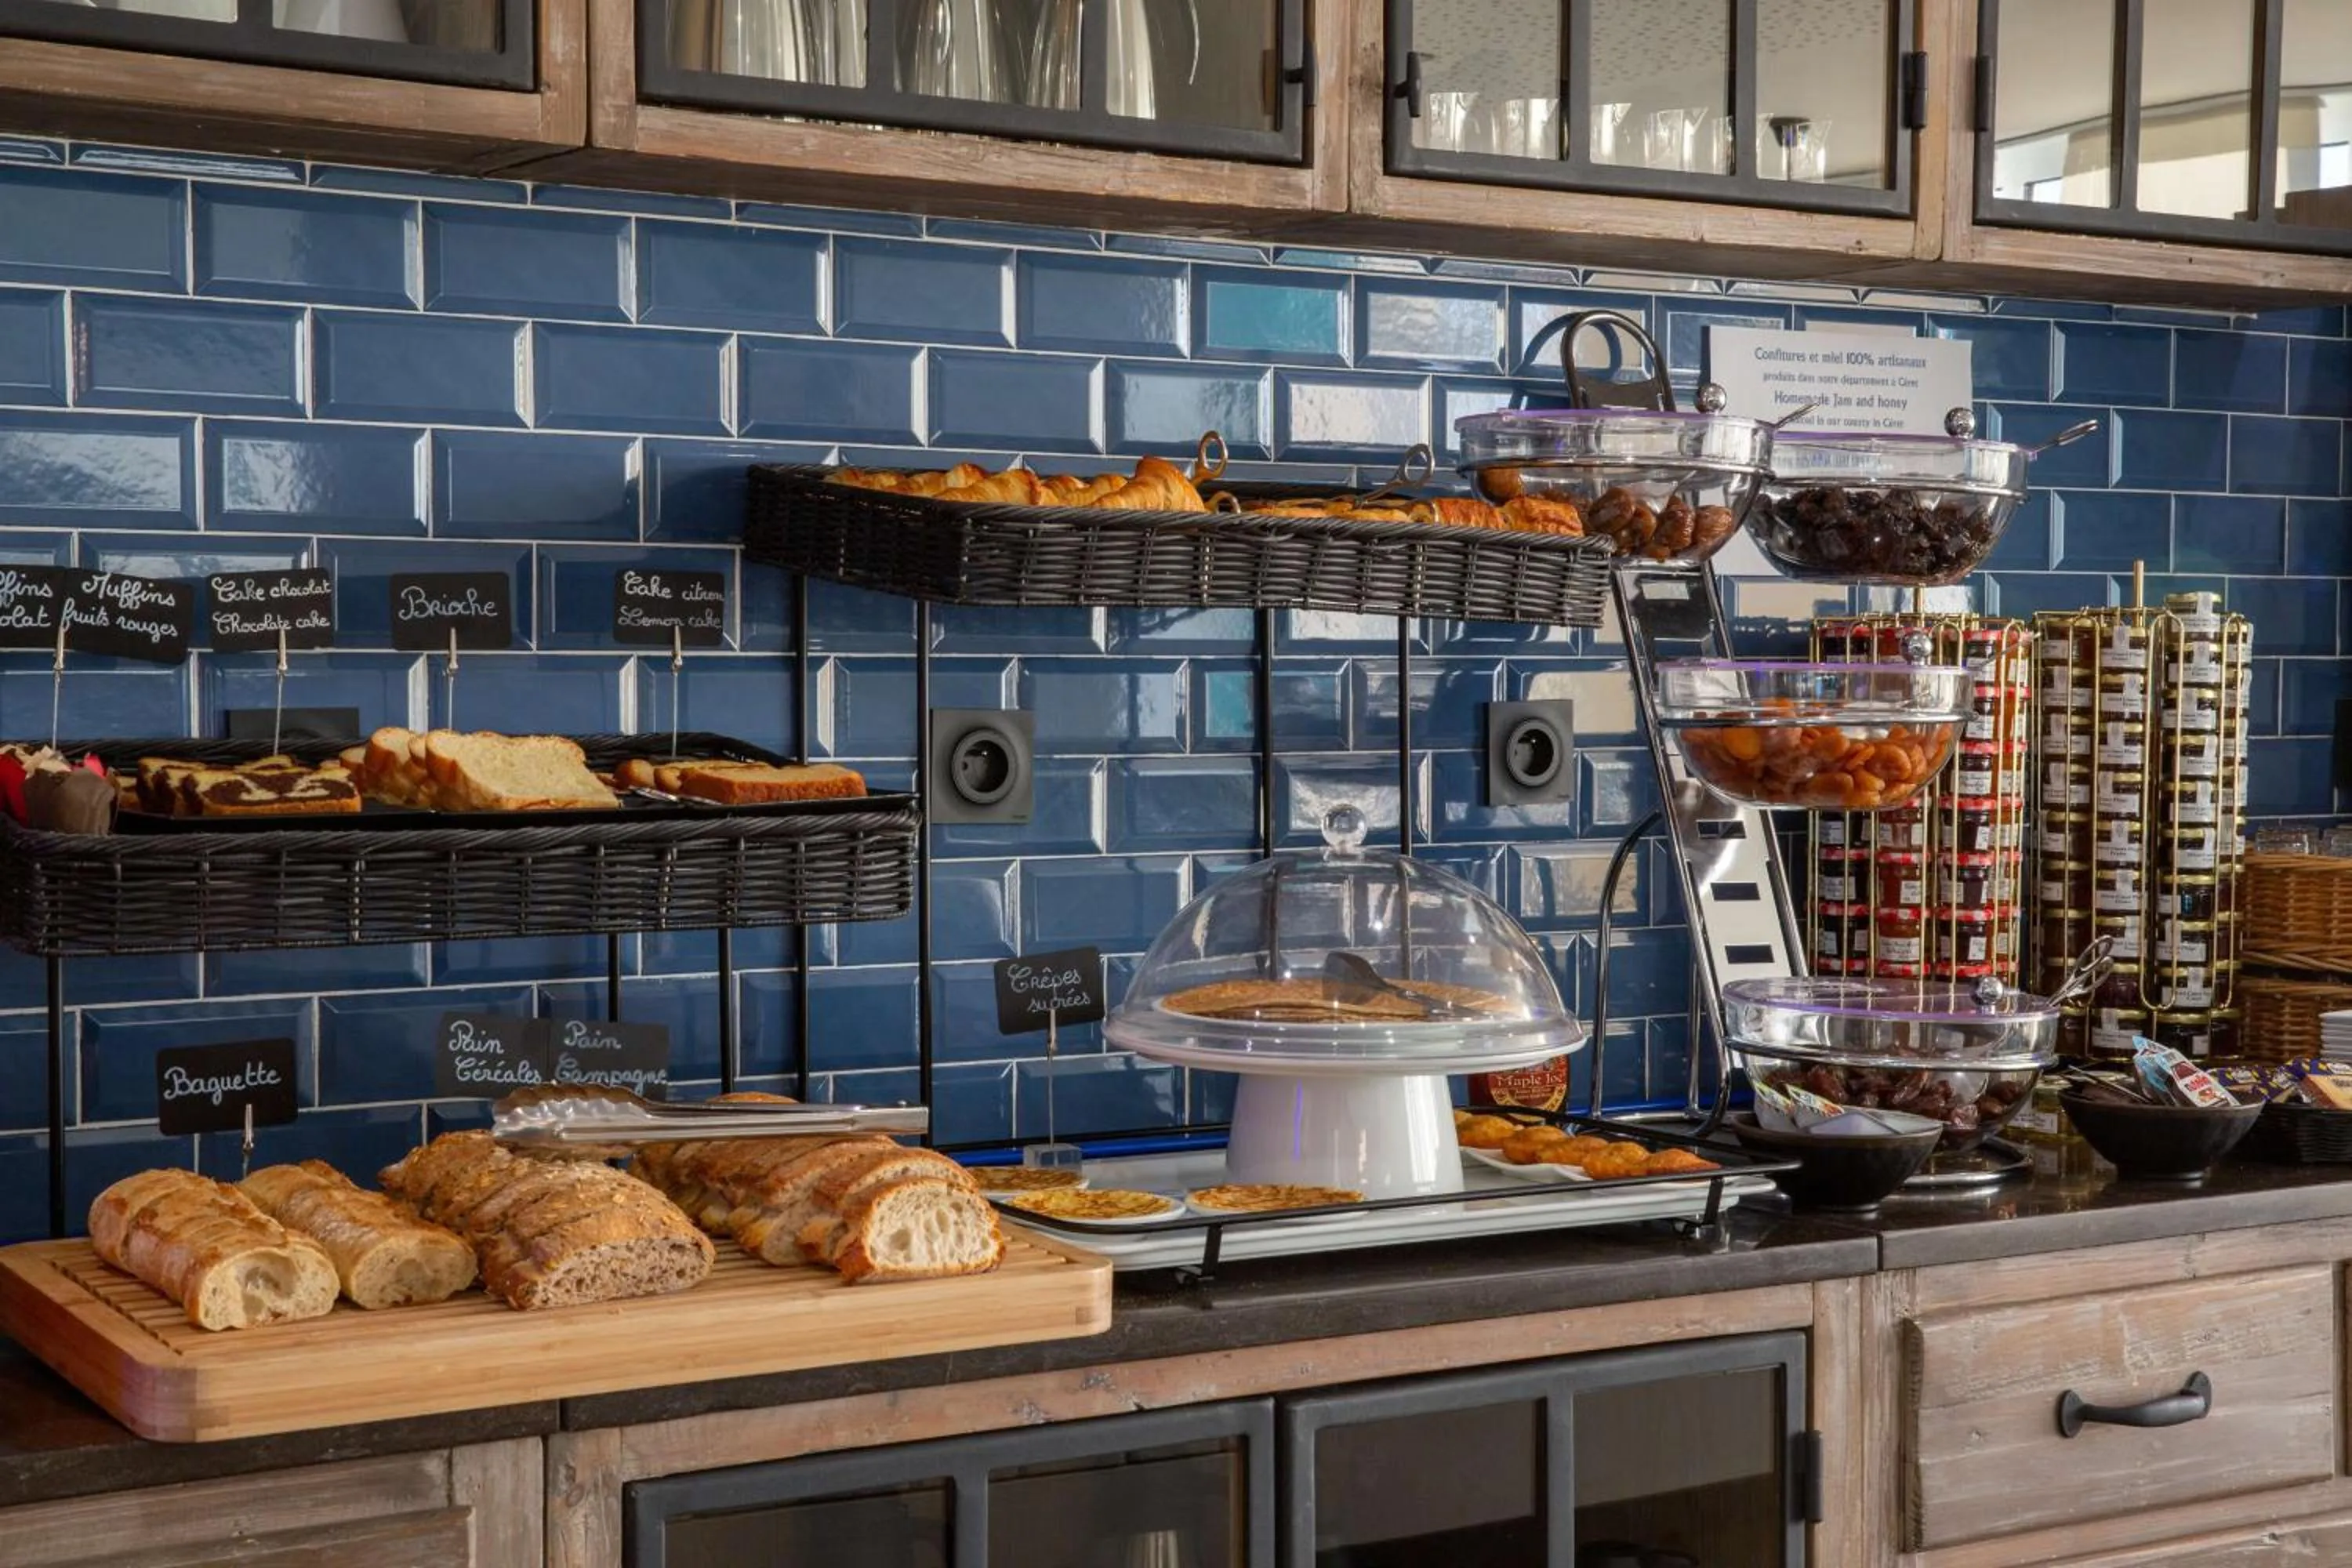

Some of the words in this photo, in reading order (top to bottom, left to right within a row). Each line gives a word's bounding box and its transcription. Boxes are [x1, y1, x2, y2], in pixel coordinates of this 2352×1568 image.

[1755, 347, 1806, 361] Confitures
[1809, 352, 1820, 362] et
[1822, 350, 1844, 364] miel
[1846, 351, 1875, 365] 100%
[1833, 393, 1852, 408] Jam
[1856, 395, 1875, 408] and
[1878, 394, 1907, 412] honey
[82, 572, 176, 609] Muffins
[211, 577, 265, 602] Cake
[270, 578, 332, 598] chocolat
[624, 570, 673, 599] Cake
[681, 581, 725, 601] citron
[398, 586, 498, 620] Brioche
[617, 605, 684, 626] Lemon
[688, 608, 722, 628] cake
[62, 597, 110, 633] fruits
[116, 615, 179, 643] rouges
[212, 612, 292, 635] Chocolate
[296, 609, 330, 628] cake
[1007, 964, 1081, 997] Crêpes
[448, 1020, 505, 1054] Pain
[564, 1020, 622, 1049] Pain
[163, 1061, 281, 1105] Baguette
[455, 1055, 542, 1084] Céréales
[554, 1053, 666, 1096] Campagne
[1496, 1074, 1541, 1088] Maple
